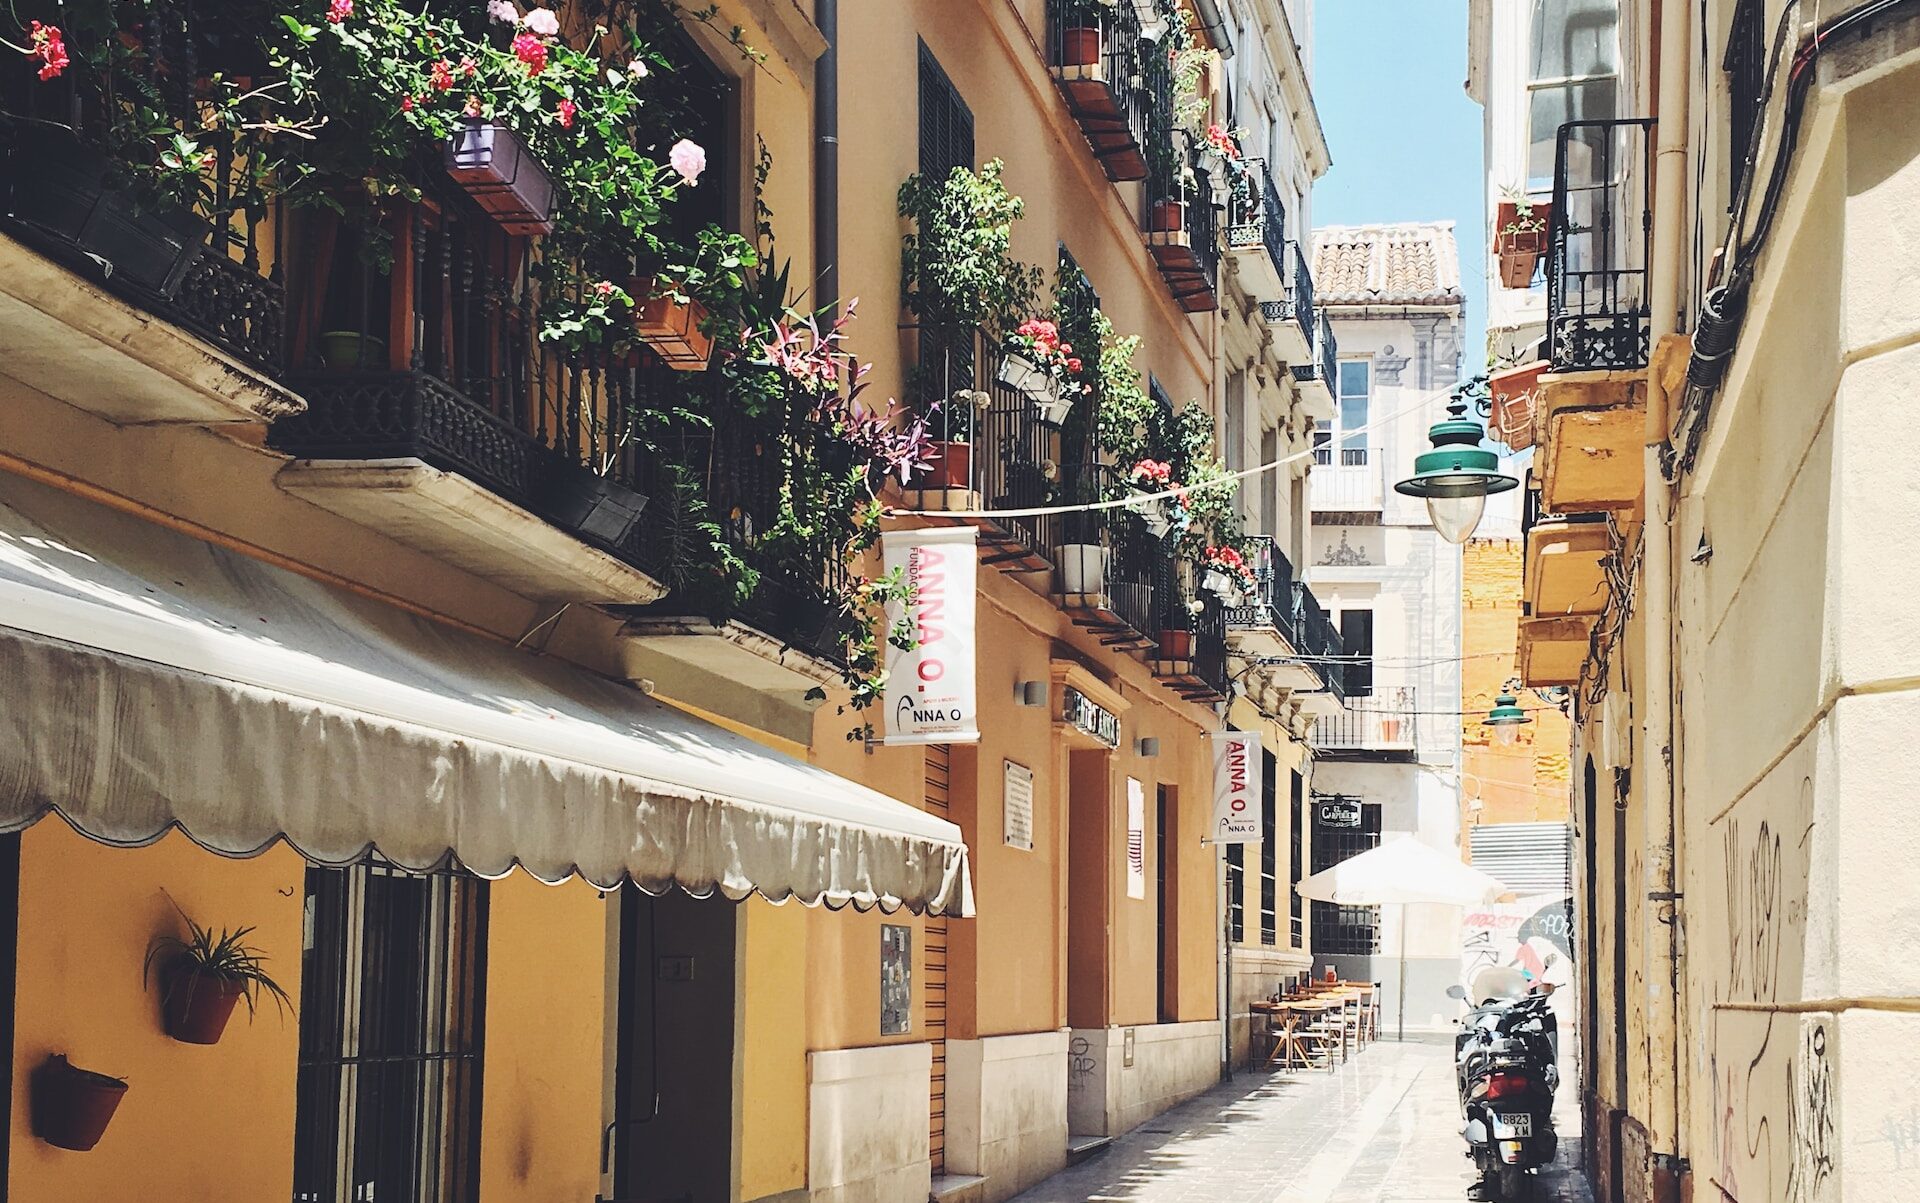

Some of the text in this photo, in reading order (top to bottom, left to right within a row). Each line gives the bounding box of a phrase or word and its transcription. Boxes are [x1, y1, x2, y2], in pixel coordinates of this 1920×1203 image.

[918, 547, 945, 646] ANNA
[917, 658, 945, 693] O.
[950, 708, 962, 721] O
[1230, 741, 1246, 794] ANNA
[1230, 799, 1246, 817] O.
[1248, 825, 1256, 833] O
[1502, 1114, 1529, 1125] 6823
